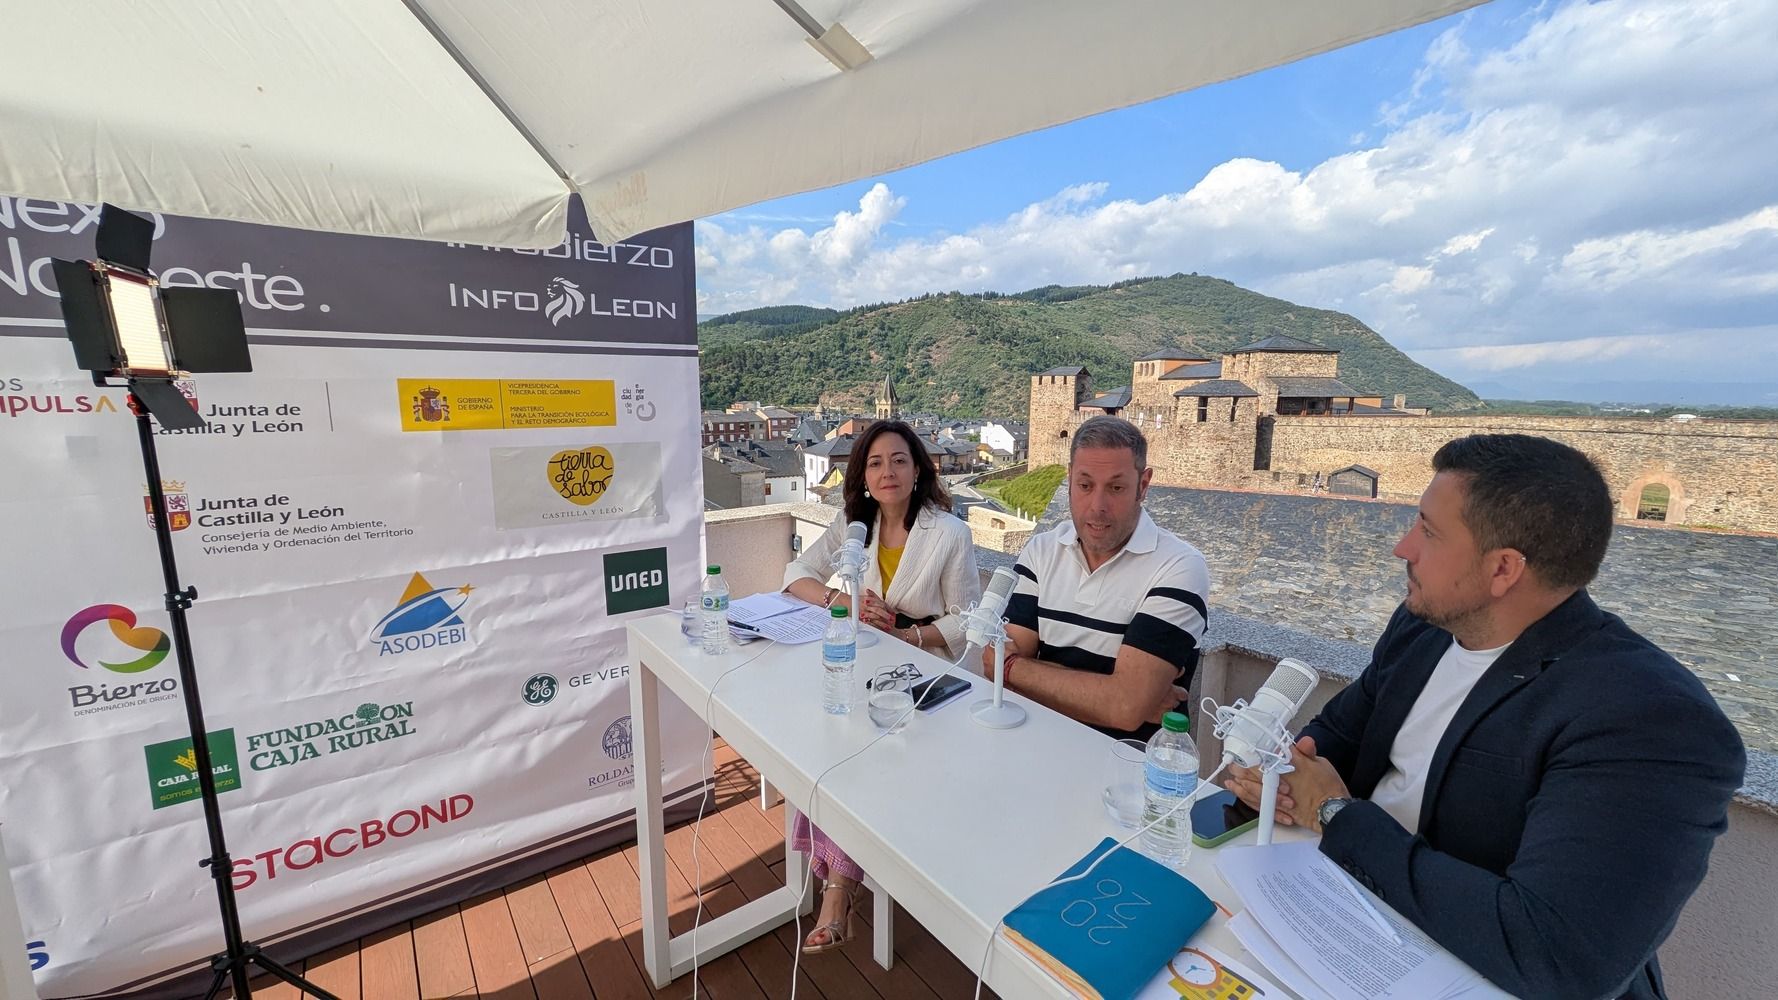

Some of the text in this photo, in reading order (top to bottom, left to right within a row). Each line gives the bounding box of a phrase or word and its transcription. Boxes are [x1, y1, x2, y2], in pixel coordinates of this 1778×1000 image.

[449, 283, 677, 320] INFO LEON
[206, 403, 301, 417] Junta de
[468, 403, 494, 411] ESPAÑA
[232, 423, 245, 437] y
[252, 419, 304, 433] León
[548, 452, 613, 471] tierra
[555, 470, 575, 482] de
[560, 470, 613, 498] sabor
[196, 494, 290, 511] Junta de
[542, 509, 588, 520] CASTILLA
[600, 506, 624, 515] LEÓN
[198, 505, 345, 527] Castilla y León
[201, 519, 387, 543] Consejería de Medio Ambiente,
[203, 527, 414, 555] Vivienda y Ordenación del Territorio
[611, 569, 663, 593] UNED
[379, 627, 467, 656] ASODEBI
[568, 665, 630, 688] GE VER
[68, 678, 178, 708] Bierzo
[149, 694, 178, 704] ORIGEN
[250, 720, 417, 772] CAJA RURAL
[158, 764, 232, 787] CAJA RAL
